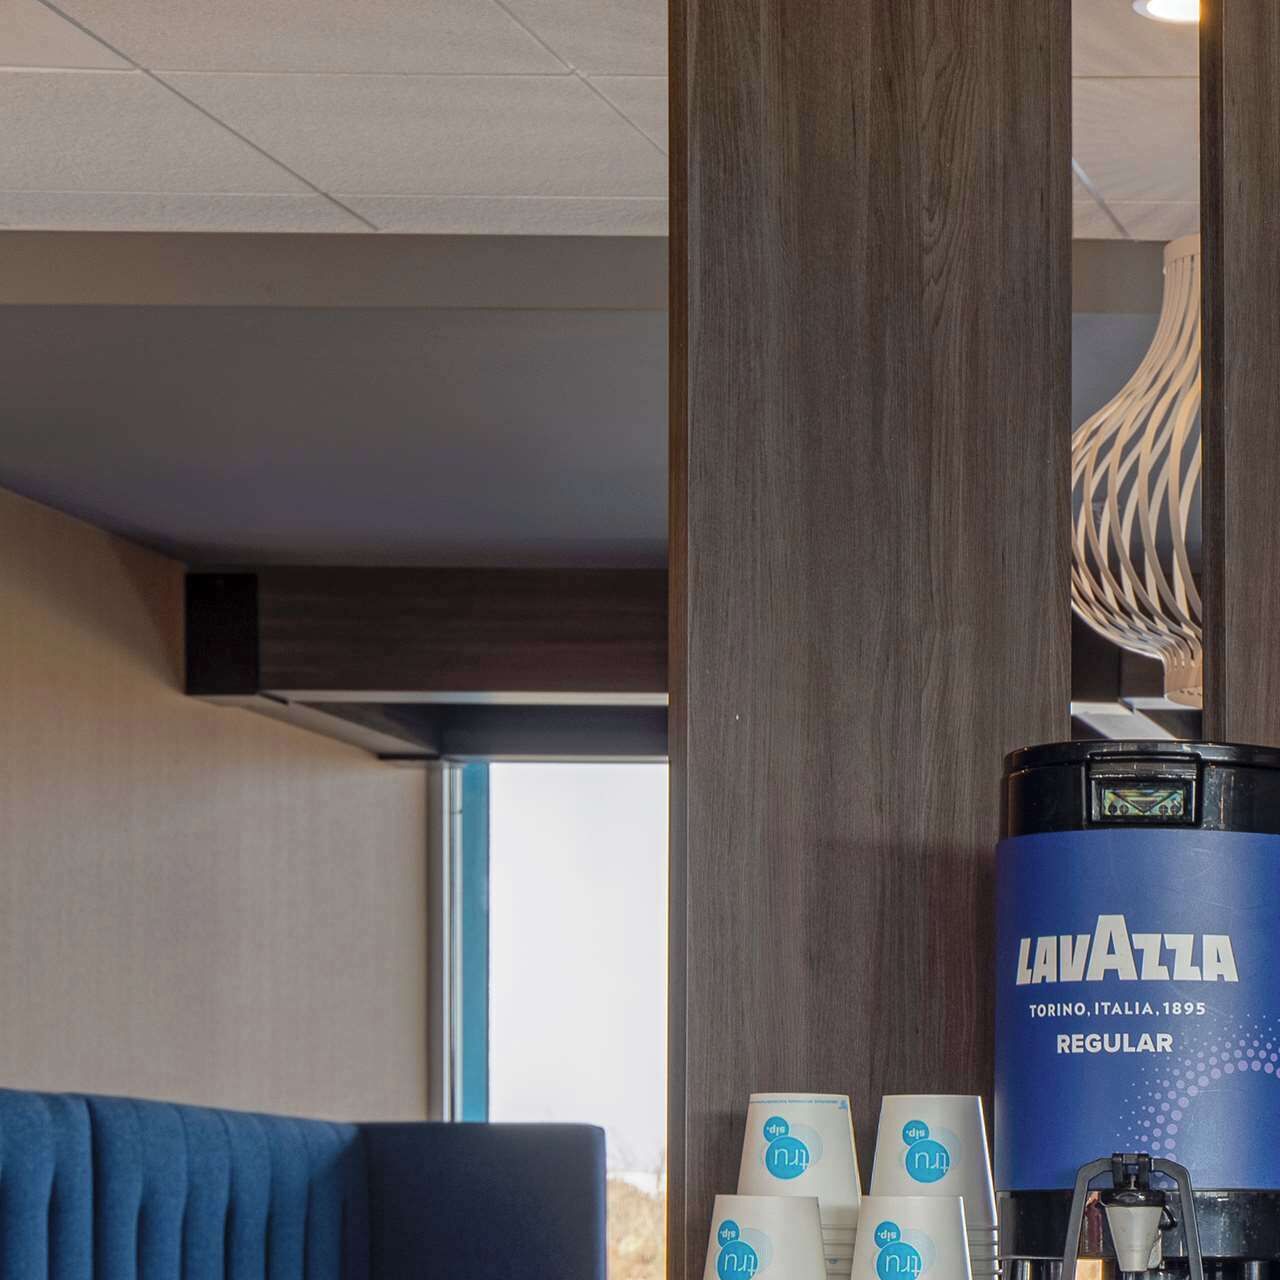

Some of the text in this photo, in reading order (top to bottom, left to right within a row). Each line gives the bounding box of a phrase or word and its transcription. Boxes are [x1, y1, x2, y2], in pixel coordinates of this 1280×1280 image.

[1016, 914, 1239, 985] LAVAZZA
[1029, 1001, 1206, 1018] TORINO, ITALIA, 1895
[1057, 1033, 1173, 1054] REGULAR
[773, 1148, 809, 1170] tru
[914, 1151, 949, 1173] tru
[724, 1253, 757, 1277] tru
[885, 1254, 920, 1277] tru
